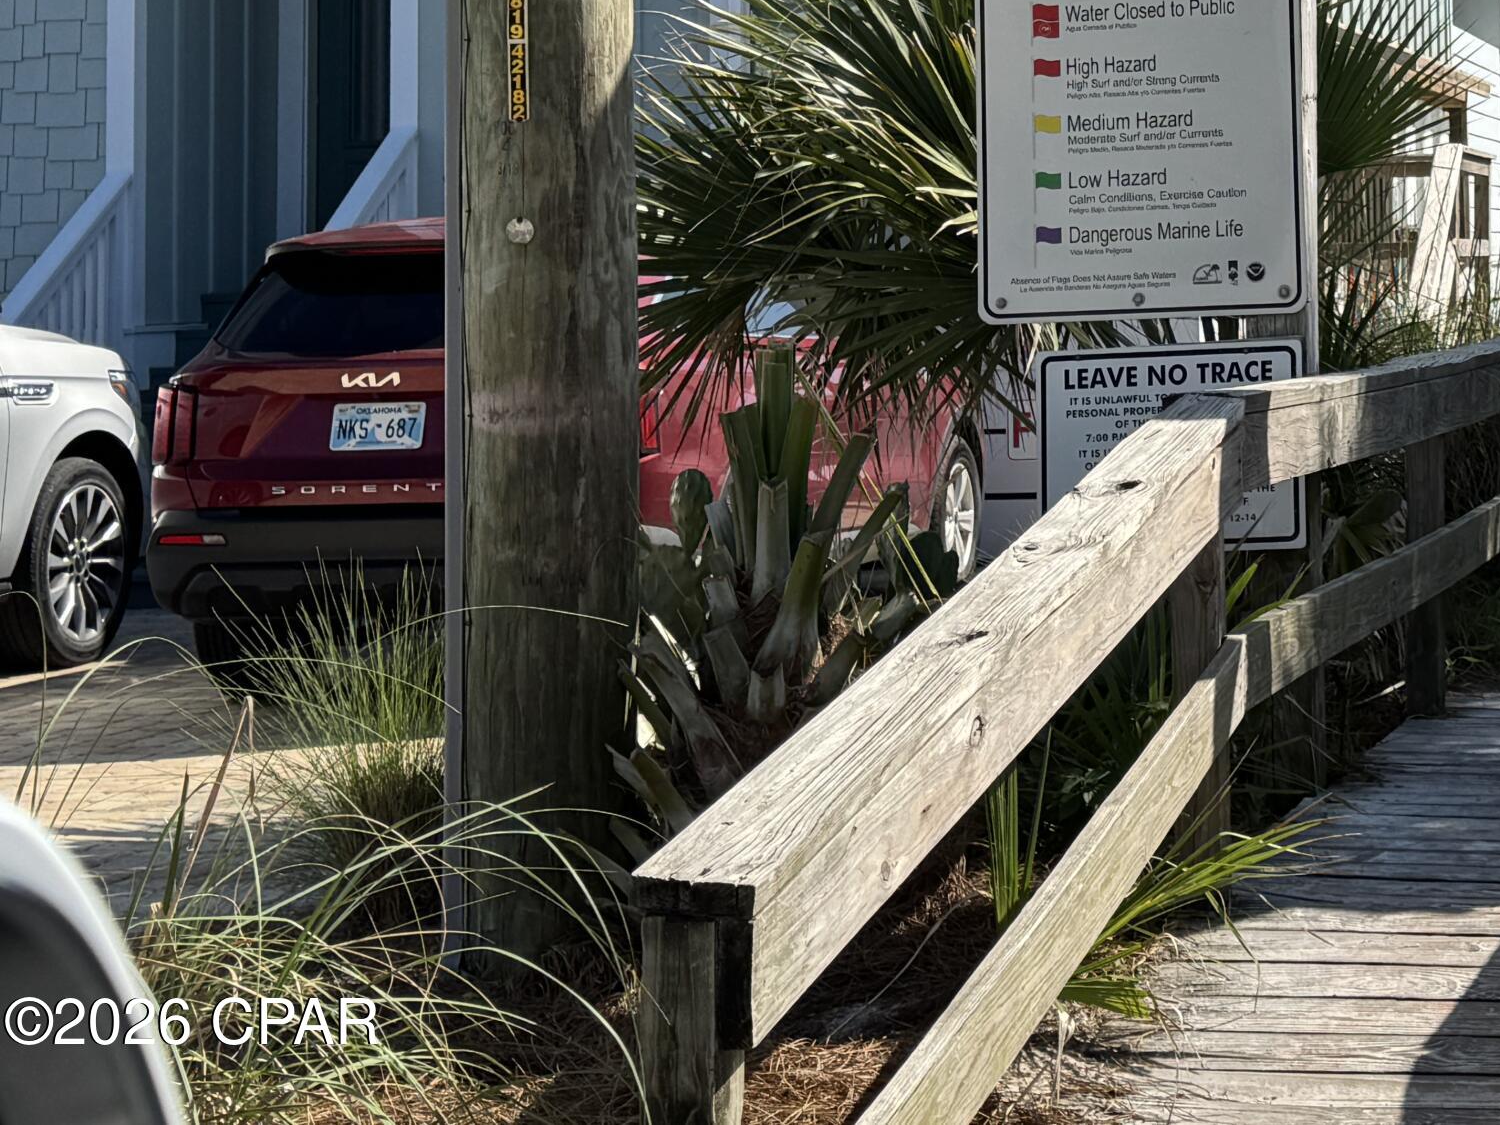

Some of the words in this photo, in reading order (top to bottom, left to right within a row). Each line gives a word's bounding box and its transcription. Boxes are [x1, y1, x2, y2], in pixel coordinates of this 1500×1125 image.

[1065, 5, 1109, 23] Water
[1114, 0, 1165, 20] Closed
[1171, 0, 1184, 17] to
[1066, 57, 1099, 79] High
[1105, 54, 1156, 74] Hazard
[511, 44, 525, 120] 42182
[1067, 79, 1088, 92] High
[1091, 78, 1110, 88] Surf
[1113, 76, 1142, 87] and/or
[1146, 76, 1176, 87] Strong
[1179, 73, 1220, 84] Currents
[1067, 114, 1130, 133] Medium
[1136, 109, 1193, 129] Hazard
[1068, 134, 1116, 146] Moderate
[1119, 132, 1141, 142] Surf
[1144, 130, 1176, 141] and/or
[1179, 128, 1224, 140] Currents
[1068, 171, 1102, 189] Low
[1108, 168, 1167, 187] Hazard
[1069, 194, 1095, 205] Calm
[1099, 192, 1156, 204] Conditions,
[1160, 190, 1204, 201] Exercise
[1207, 187, 1247, 199] Caution
[1069, 225, 1152, 247] Dangerous
[1158, 221, 1210, 240] Marine
[1216, 219, 1243, 237] Life
[1010, 277, 1041, 285] Absence
[1043, 276, 1051, 284] of
[1052, 275, 1071, 284] Flags
[1093, 274, 1105, 282] Not
[1107, 273, 1131, 281] Assure
[1134, 272, 1150, 280] Safe
[341, 371, 400, 388] KIA
[1064, 366, 1137, 390] LEAVE
[1150, 364, 1187, 387] NO
[1196, 360, 1273, 384] TRACE
[1070, 397, 1079, 406] IT
[1082, 396, 1091, 405] IS
[1095, 394, 1153, 405] UNLAWFUL
[356, 407, 402, 415] OKLAHOMA
[1066, 408, 1120, 419] PERSONAL
[1124, 406, 1164, 416] PROPER
[1115, 420, 1129, 428] OF
[1086, 433, 1108, 442] 7:00
[1079, 450, 1088, 458] IT
[1091, 449, 1101, 457] IS
[271, 482, 442, 495] SORENT
[1230, 513, 1257, 522] 12-14
